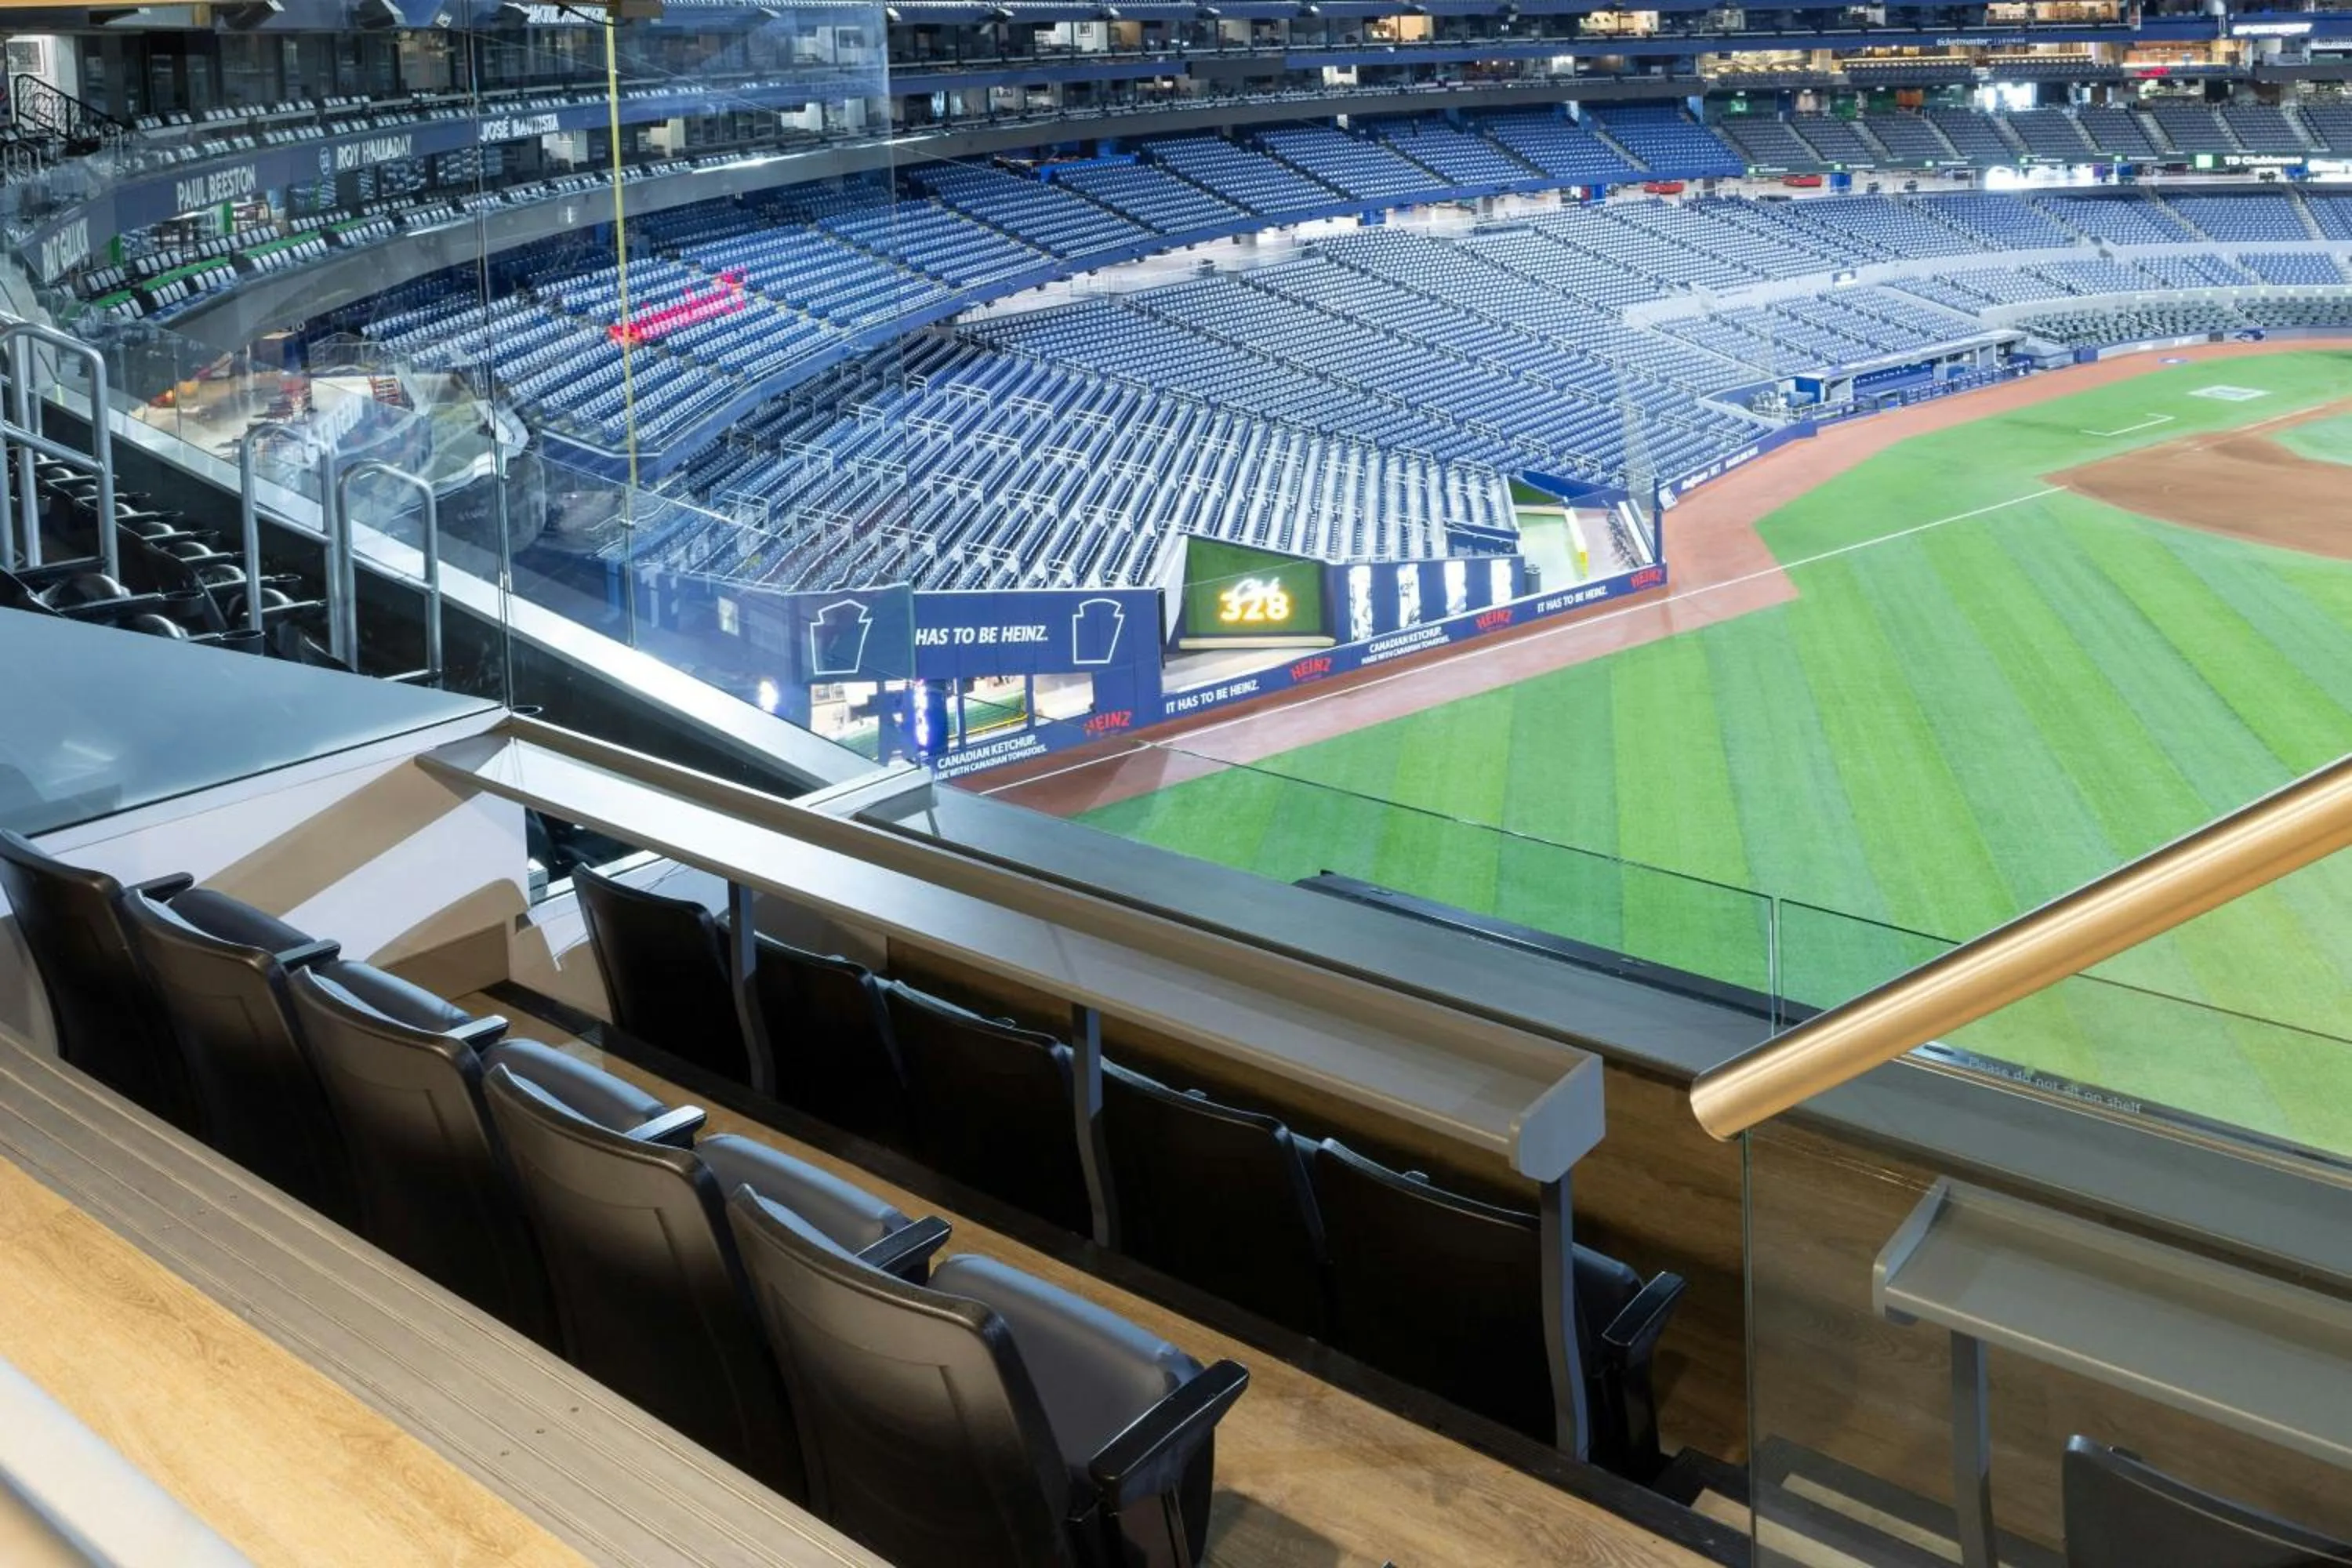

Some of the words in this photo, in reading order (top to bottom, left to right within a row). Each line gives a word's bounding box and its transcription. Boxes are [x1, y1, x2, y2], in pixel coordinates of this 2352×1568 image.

[479, 116, 510, 142] JOSÉ
[511, 113, 560, 136] BAUTISTA
[336, 145, 360, 170] ROY
[362, 134, 413, 163] HALLADAY
[176, 177, 207, 211] PAUL
[209, 165, 256, 202] BEESTON
[1630, 568, 1663, 587] HEINZ
[1219, 591, 1290, 621] 328
[1537, 602, 1544, 612] IT
[1546, 598, 1563, 611] HAS
[1563, 595, 1573, 606] TO
[1575, 592, 1584, 602] BE
[1475, 608, 1512, 629] HEINZ
[915, 627, 948, 645] HAS
[953, 627, 975, 644] TO
[978, 626, 997, 644] BE
[1001, 626, 1048, 643] HEINZ.
[1369, 636, 1408, 653] CANADIAN
[1291, 657, 1332, 681] HEINZ
[1166, 700, 1176, 713] IT
[1178, 695, 1199, 711] HAS
[1200, 691, 1214, 704] TO
[1216, 687, 1229, 701] BE
[1230, 679, 1260, 698] HEINZ.
[1083, 710, 1132, 737] HEINZ
[937, 747, 991, 769] CANADIAN
[1969, 1056, 2010, 1078] Please
[2013, 1068, 2032, 1083] do
[2035, 1077, 2060, 1091] not
[2063, 1083, 2082, 1096] sit
[2085, 1091, 2102, 1104] on
[2106, 1096, 2142, 1114] shelf
